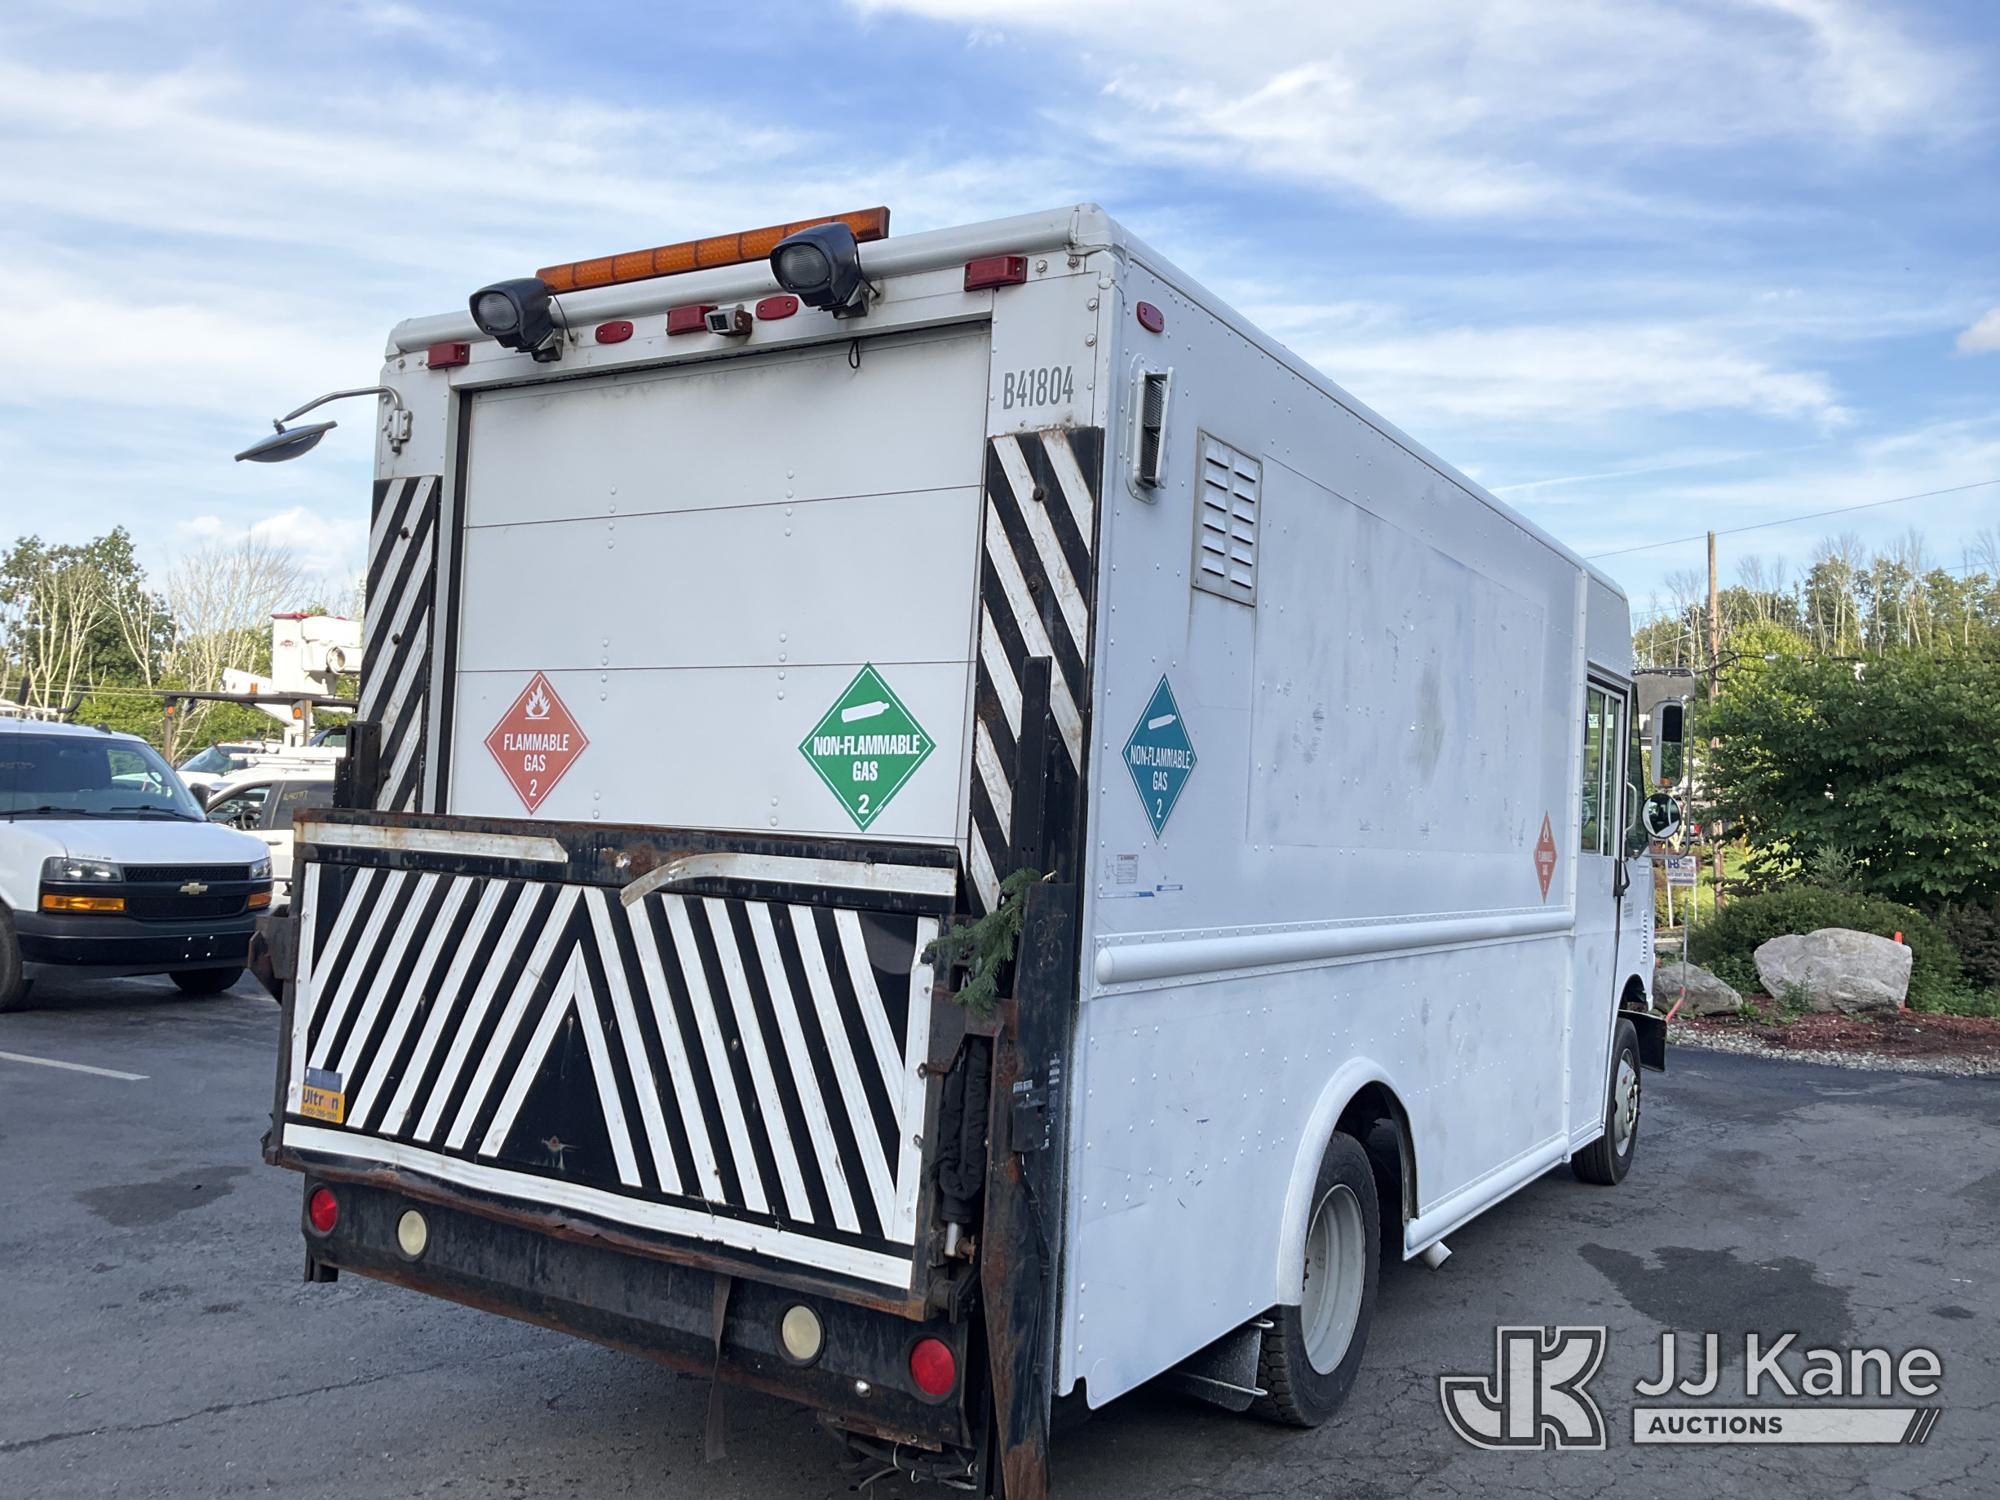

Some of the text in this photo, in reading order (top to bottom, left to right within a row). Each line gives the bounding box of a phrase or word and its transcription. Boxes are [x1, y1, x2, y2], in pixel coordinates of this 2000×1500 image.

[1003, 366, 1074, 410] B41804
[504, 733, 570, 752] FLAMMABLE
[813, 734, 920, 756] NON-FLAMMABLE
[524, 754, 547, 772] GAS
[1130, 744, 1191, 770] NON-FLAMMABLE
[852, 761, 879, 782] GAS
[1152, 771, 1169, 791] GAS
[529, 778, 538, 797] 2
[857, 793, 870, 814] 2
[1155, 798, 1163, 818] 2
[303, 1087, 339, 1110] Ultrn
